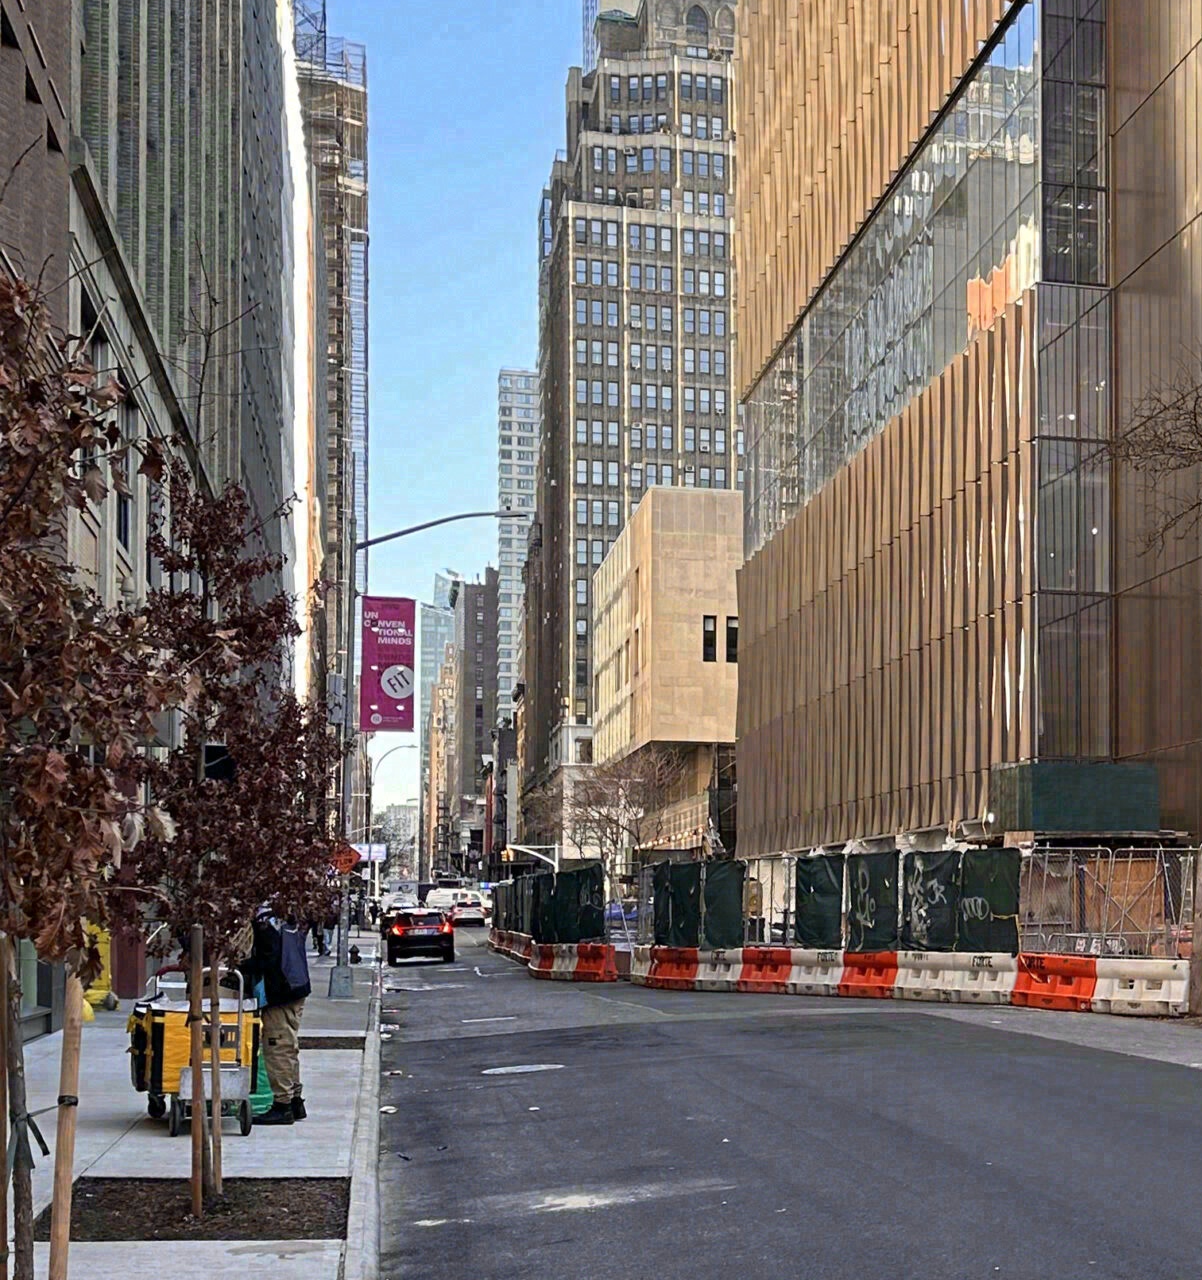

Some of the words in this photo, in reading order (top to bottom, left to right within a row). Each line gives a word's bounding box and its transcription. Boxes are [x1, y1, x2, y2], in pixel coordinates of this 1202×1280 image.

[364, 611, 379, 620] UN
[377, 637, 412, 646] MINDS
[386, 670, 410, 693] FIT
[971, 954, 992, 968] FORTE
